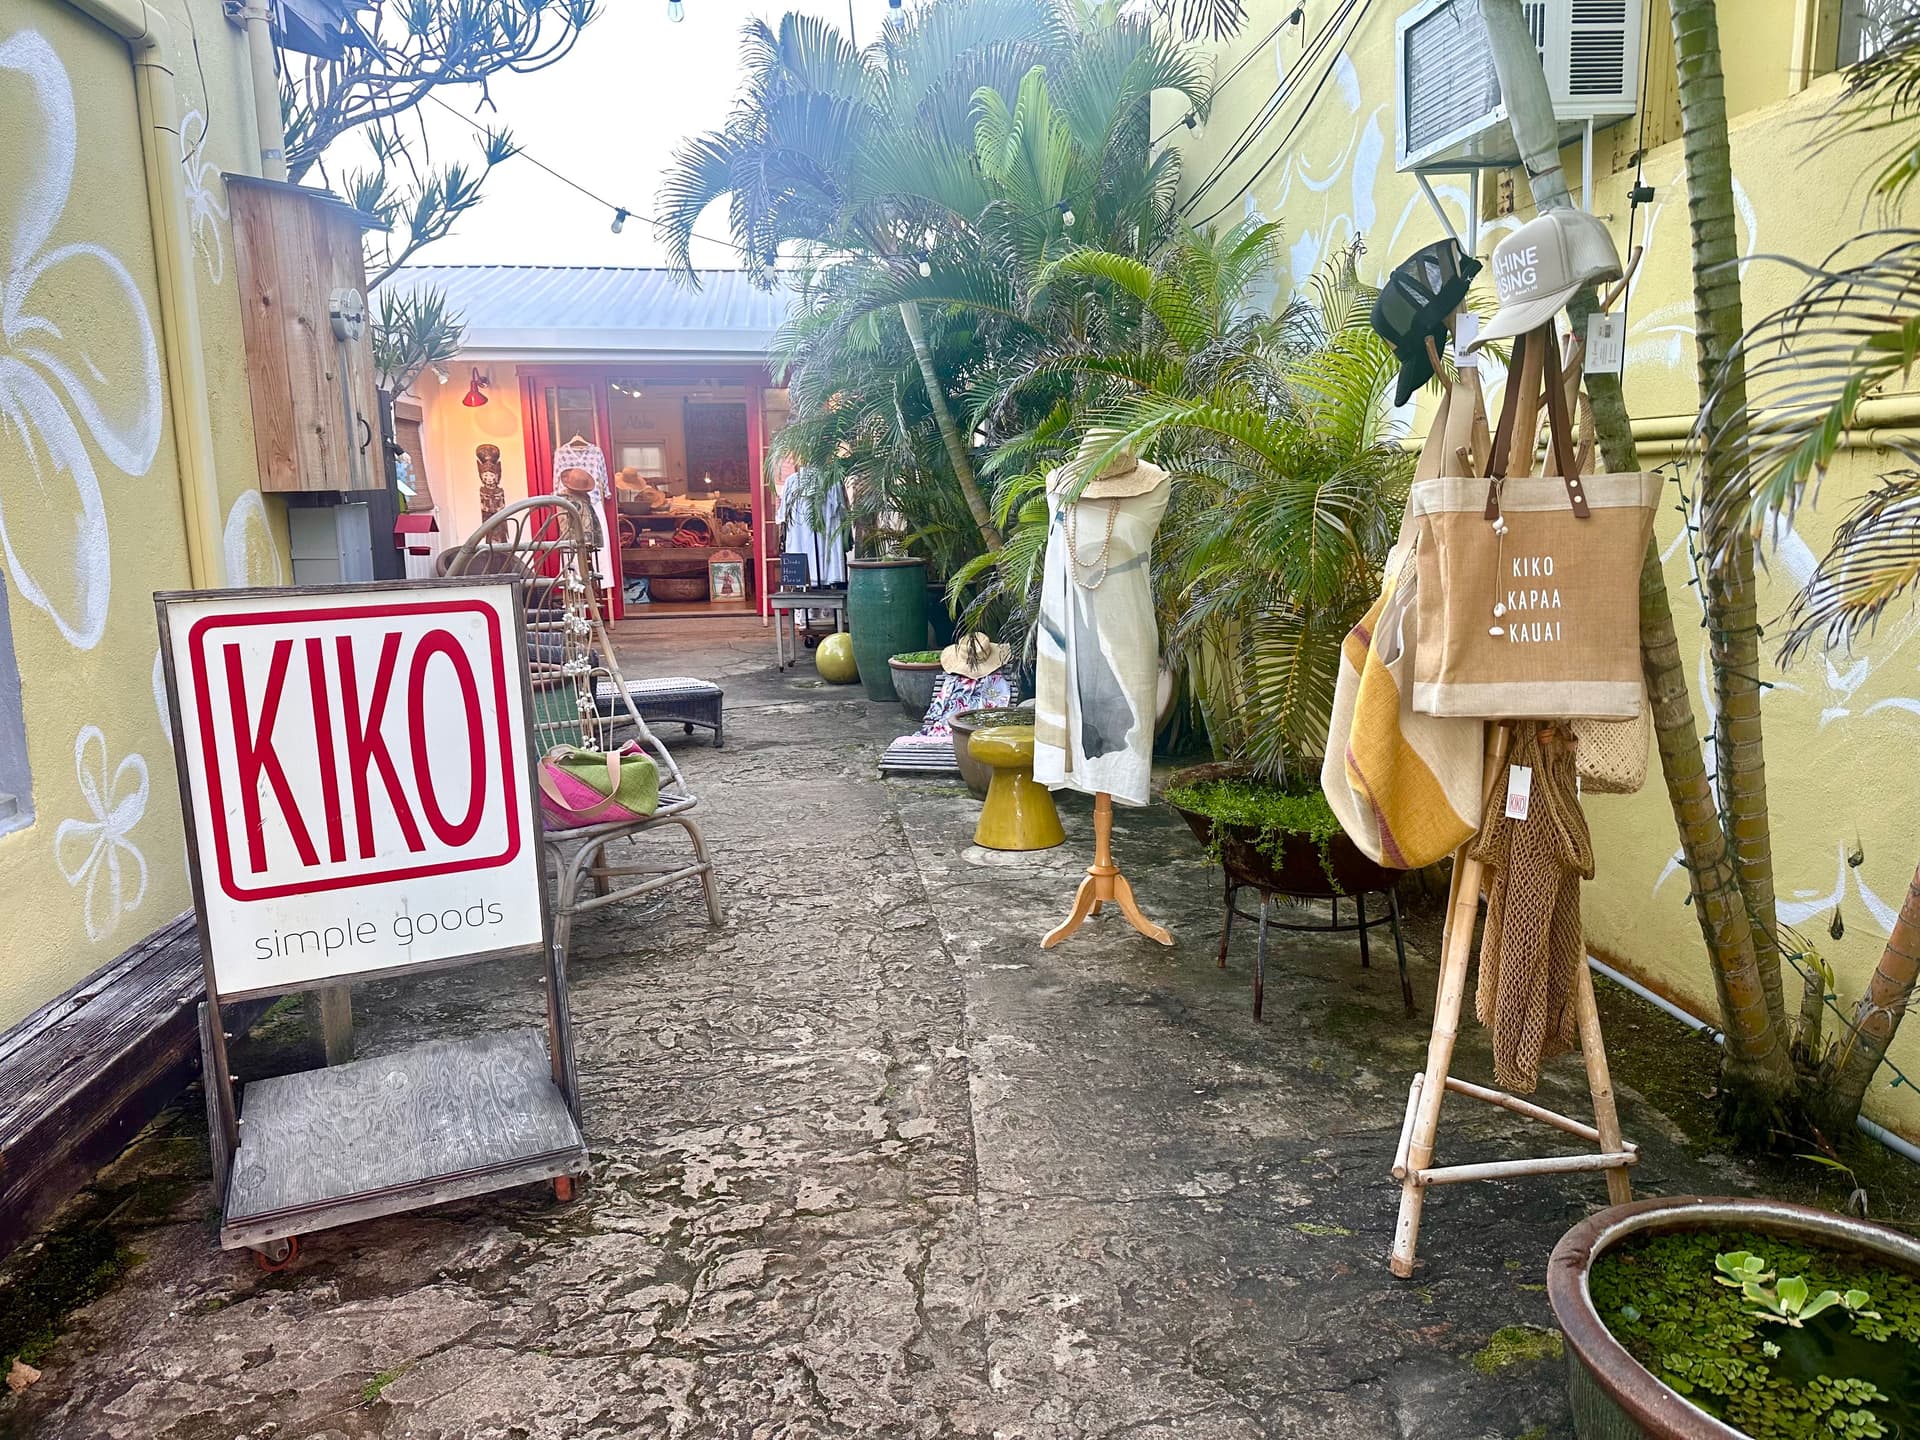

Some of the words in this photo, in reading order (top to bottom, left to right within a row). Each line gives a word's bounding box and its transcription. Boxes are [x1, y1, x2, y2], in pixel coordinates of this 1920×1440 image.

[1494, 246, 1539, 277] AHINE
[1513, 556, 1553, 577] KIKO
[1508, 588, 1561, 610] KAPAA
[1509, 622, 1561, 643] KAUAI
[223, 629, 487, 874] KIKO
[255, 918, 377, 960] simple
[393, 898, 504, 946] goods
